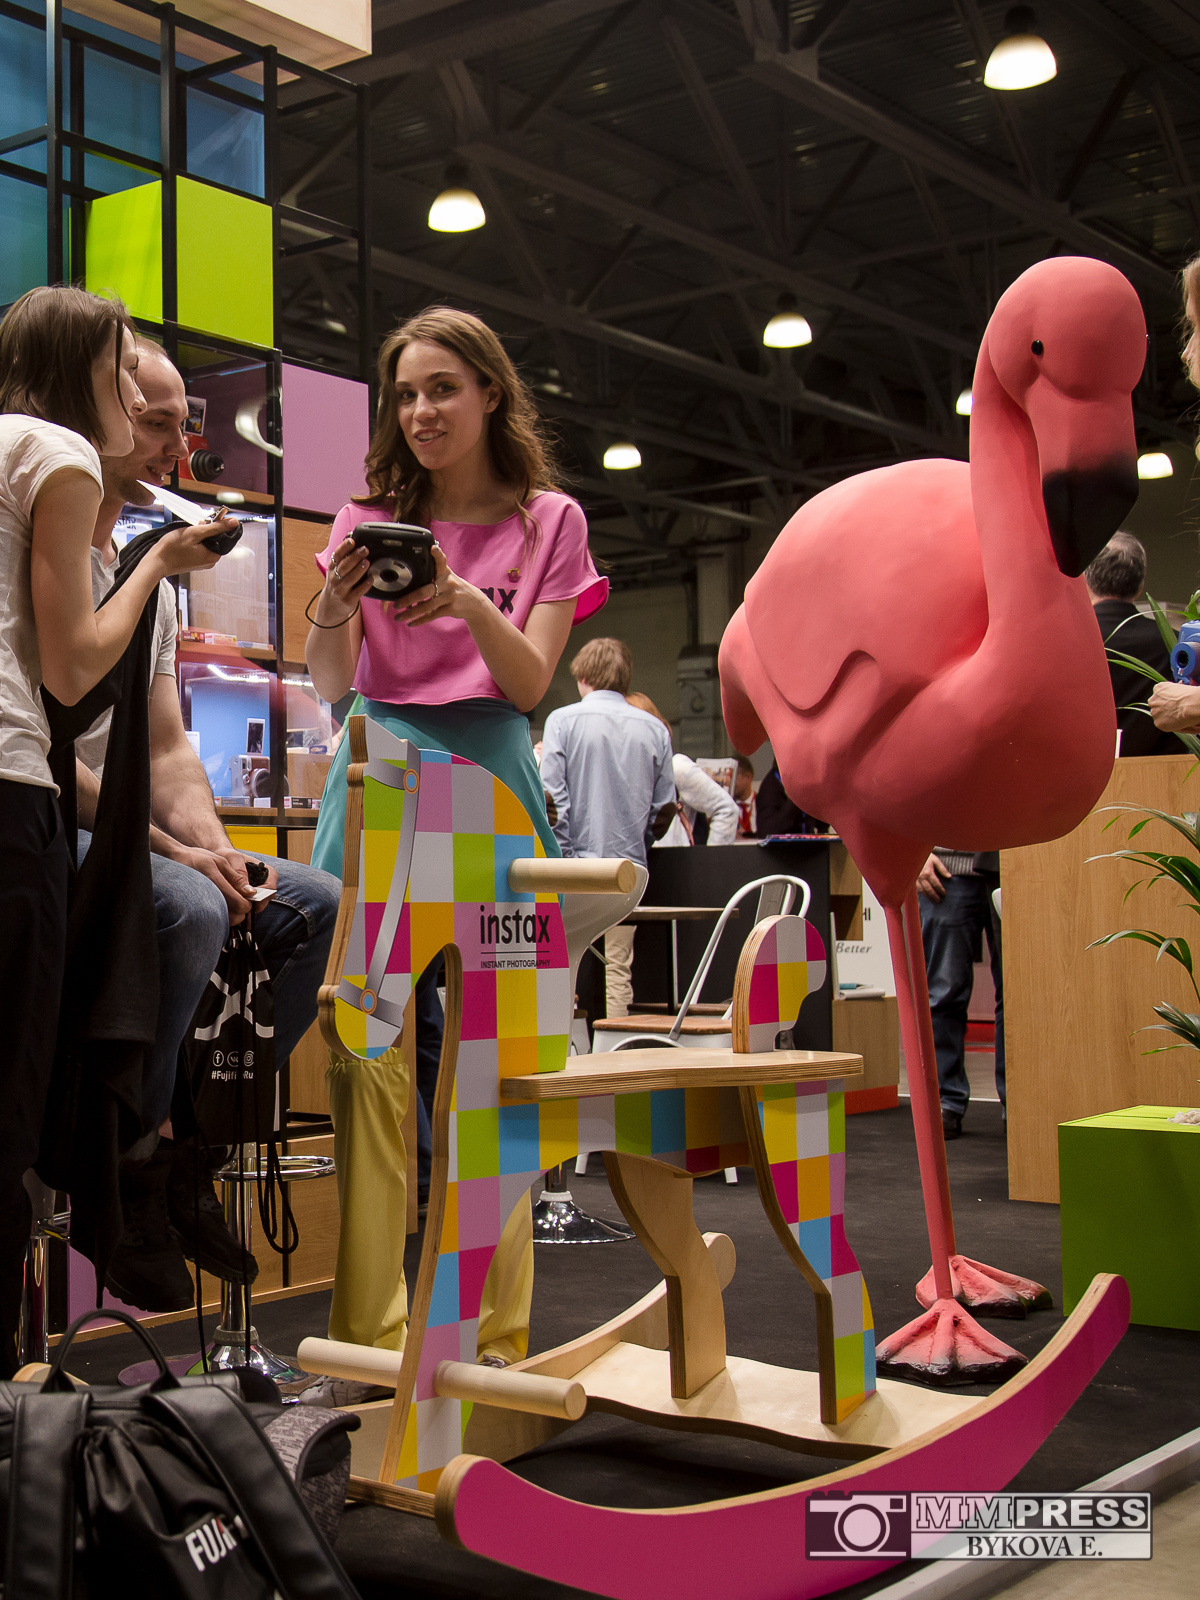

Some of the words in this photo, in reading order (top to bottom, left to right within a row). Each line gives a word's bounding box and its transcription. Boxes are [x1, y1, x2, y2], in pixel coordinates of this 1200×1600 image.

[480, 904, 550, 944] instax
[836, 942, 873, 953] Better
[481, 960, 506, 969] INSTANT
[507, 959, 550, 968] PHOTOGRAPHY
[211, 1070, 254, 1082] #FujifiRu
[185, 1518, 237, 1572] FUJI
